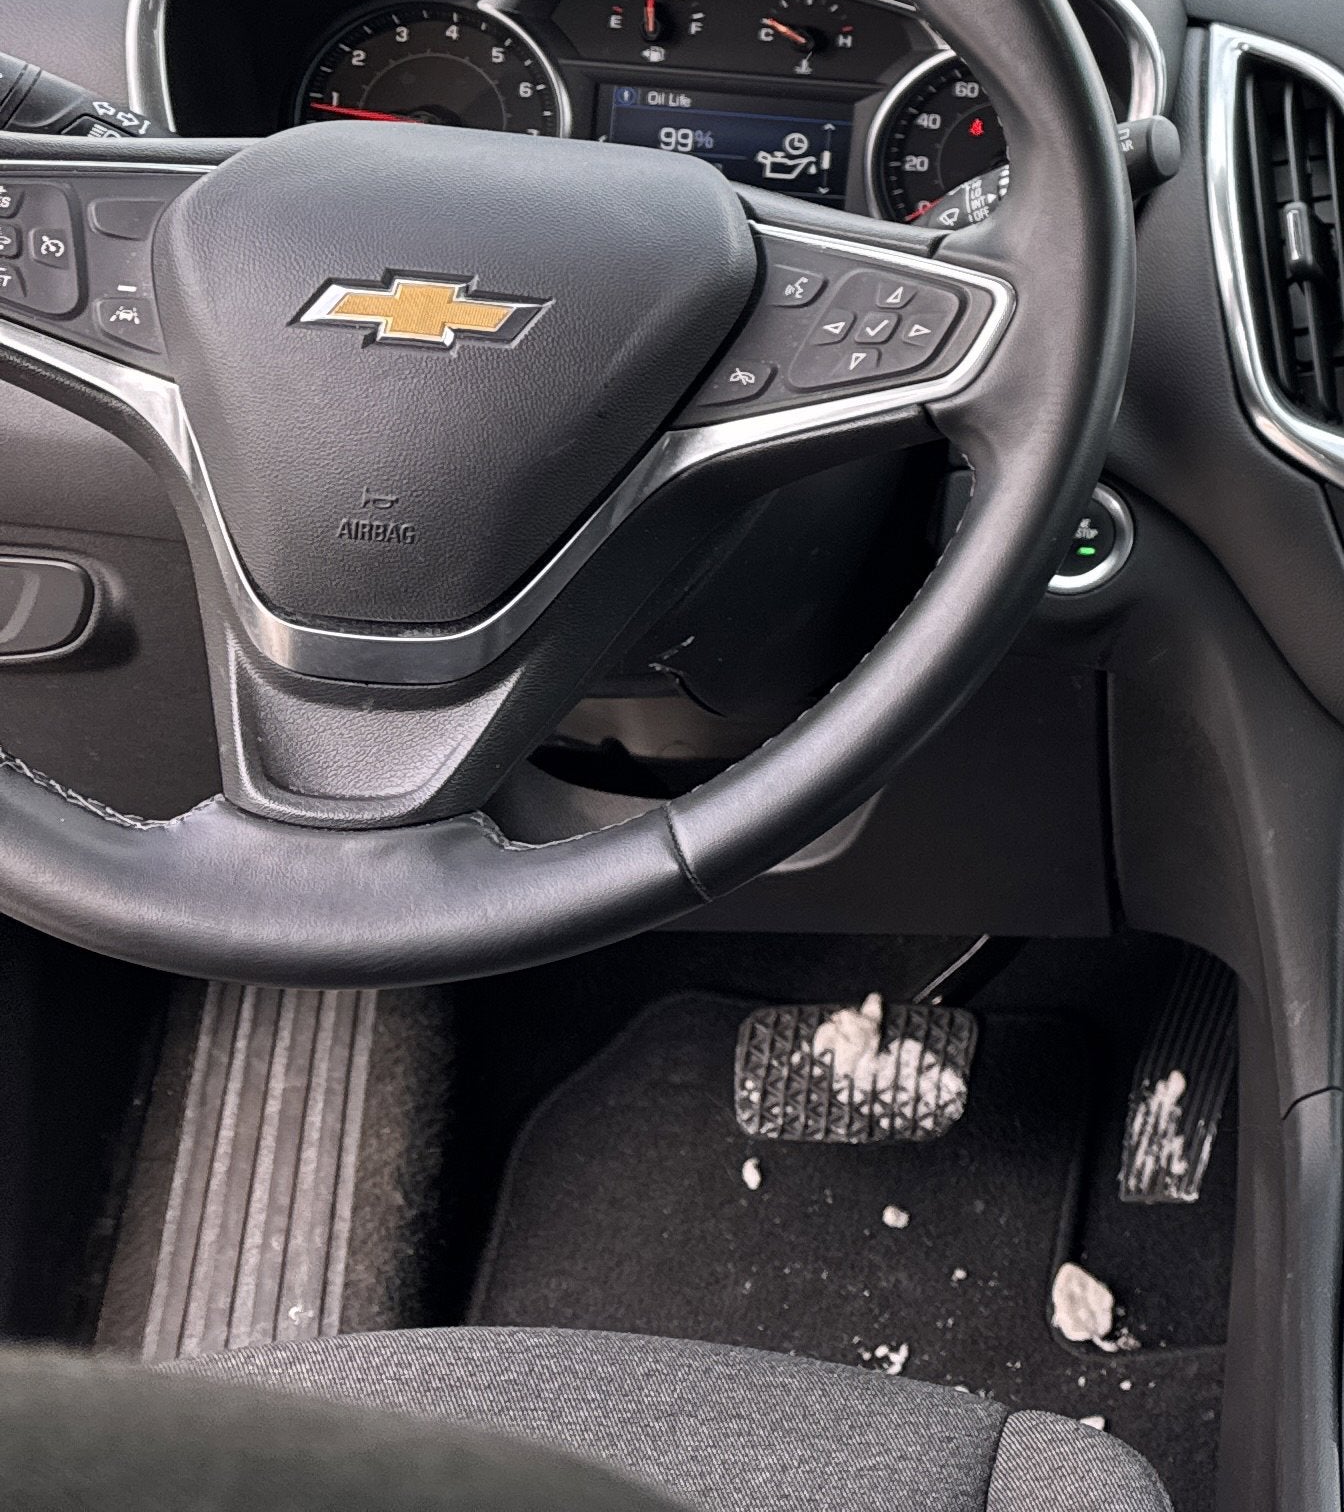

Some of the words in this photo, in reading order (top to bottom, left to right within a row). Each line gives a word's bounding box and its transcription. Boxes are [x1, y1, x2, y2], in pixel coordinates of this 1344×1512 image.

[609, 14, 623, 29] E
[690, 21, 703, 35] F
[396, 26, 409, 42] 3
[445, 25, 460, 40] 4
[759, 28, 774, 42] C
[838, 35, 852, 48] H
[351, 50, 366, 66] 2
[491, 47, 504, 63] 5
[519, 82, 532, 97] 6
[955, 82, 979, 98] 60
[331, 92, 339, 106] 1
[647, 91, 665, 106] Oil
[668, 93, 692, 108] Life
[917, 114, 941, 129] 40
[659, 127, 714, 152] 99%
[904, 155, 929, 171] 20
[970, 189, 982, 199] LO
[971, 197, 986, 210] INT
[974, 206, 990, 220] OFF
[336, 518, 416, 544] AIRBAG
